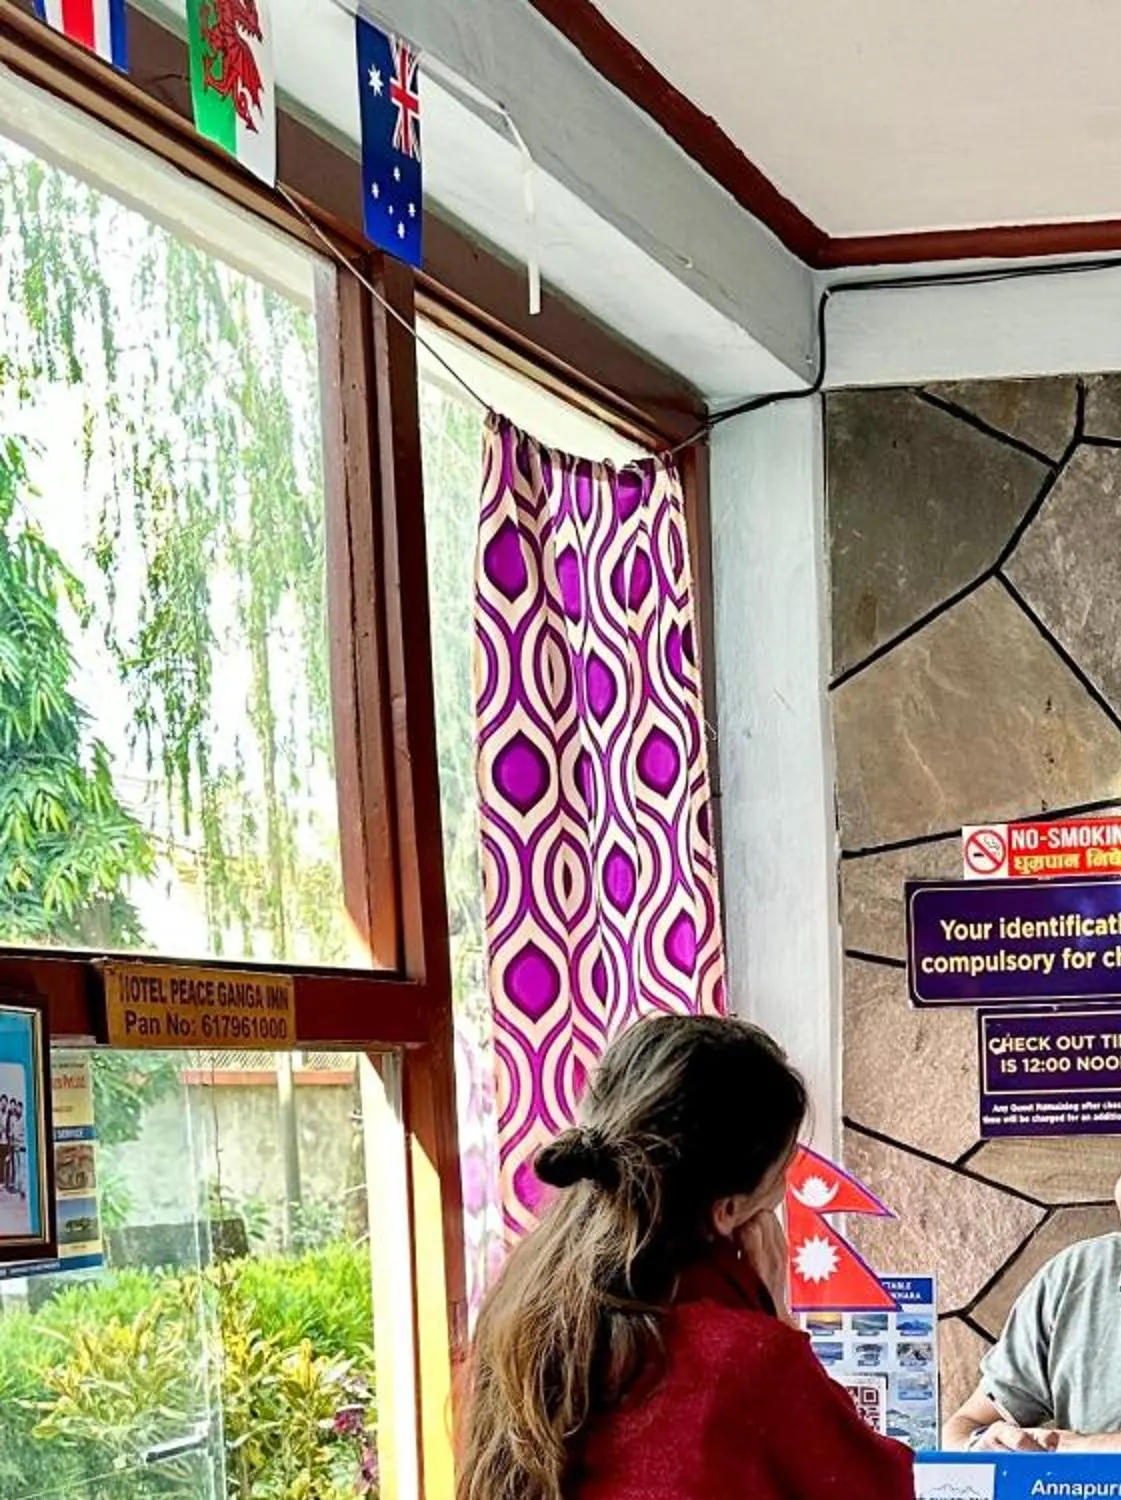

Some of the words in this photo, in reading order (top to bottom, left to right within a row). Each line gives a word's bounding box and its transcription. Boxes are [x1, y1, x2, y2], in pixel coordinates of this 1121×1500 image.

[939, 919, 993, 942] Your
[921, 949, 1056, 977] compulsory
[1061, 947, 1097, 970] for
[170, 978, 214, 1007] PEACE
[217, 981, 265, 1010] GANGA
[125, 1009, 161, 1036] Pan
[166, 1011, 196, 1037] No:
[201, 1013, 288, 1040] 617961000
[988, 1035, 1052, 1054] CHECK
[1055, 1034, 1096, 1050] OUT
[1000, 1058, 1017, 1073] IS
[1022, 1057, 1071, 1073] 12:00
